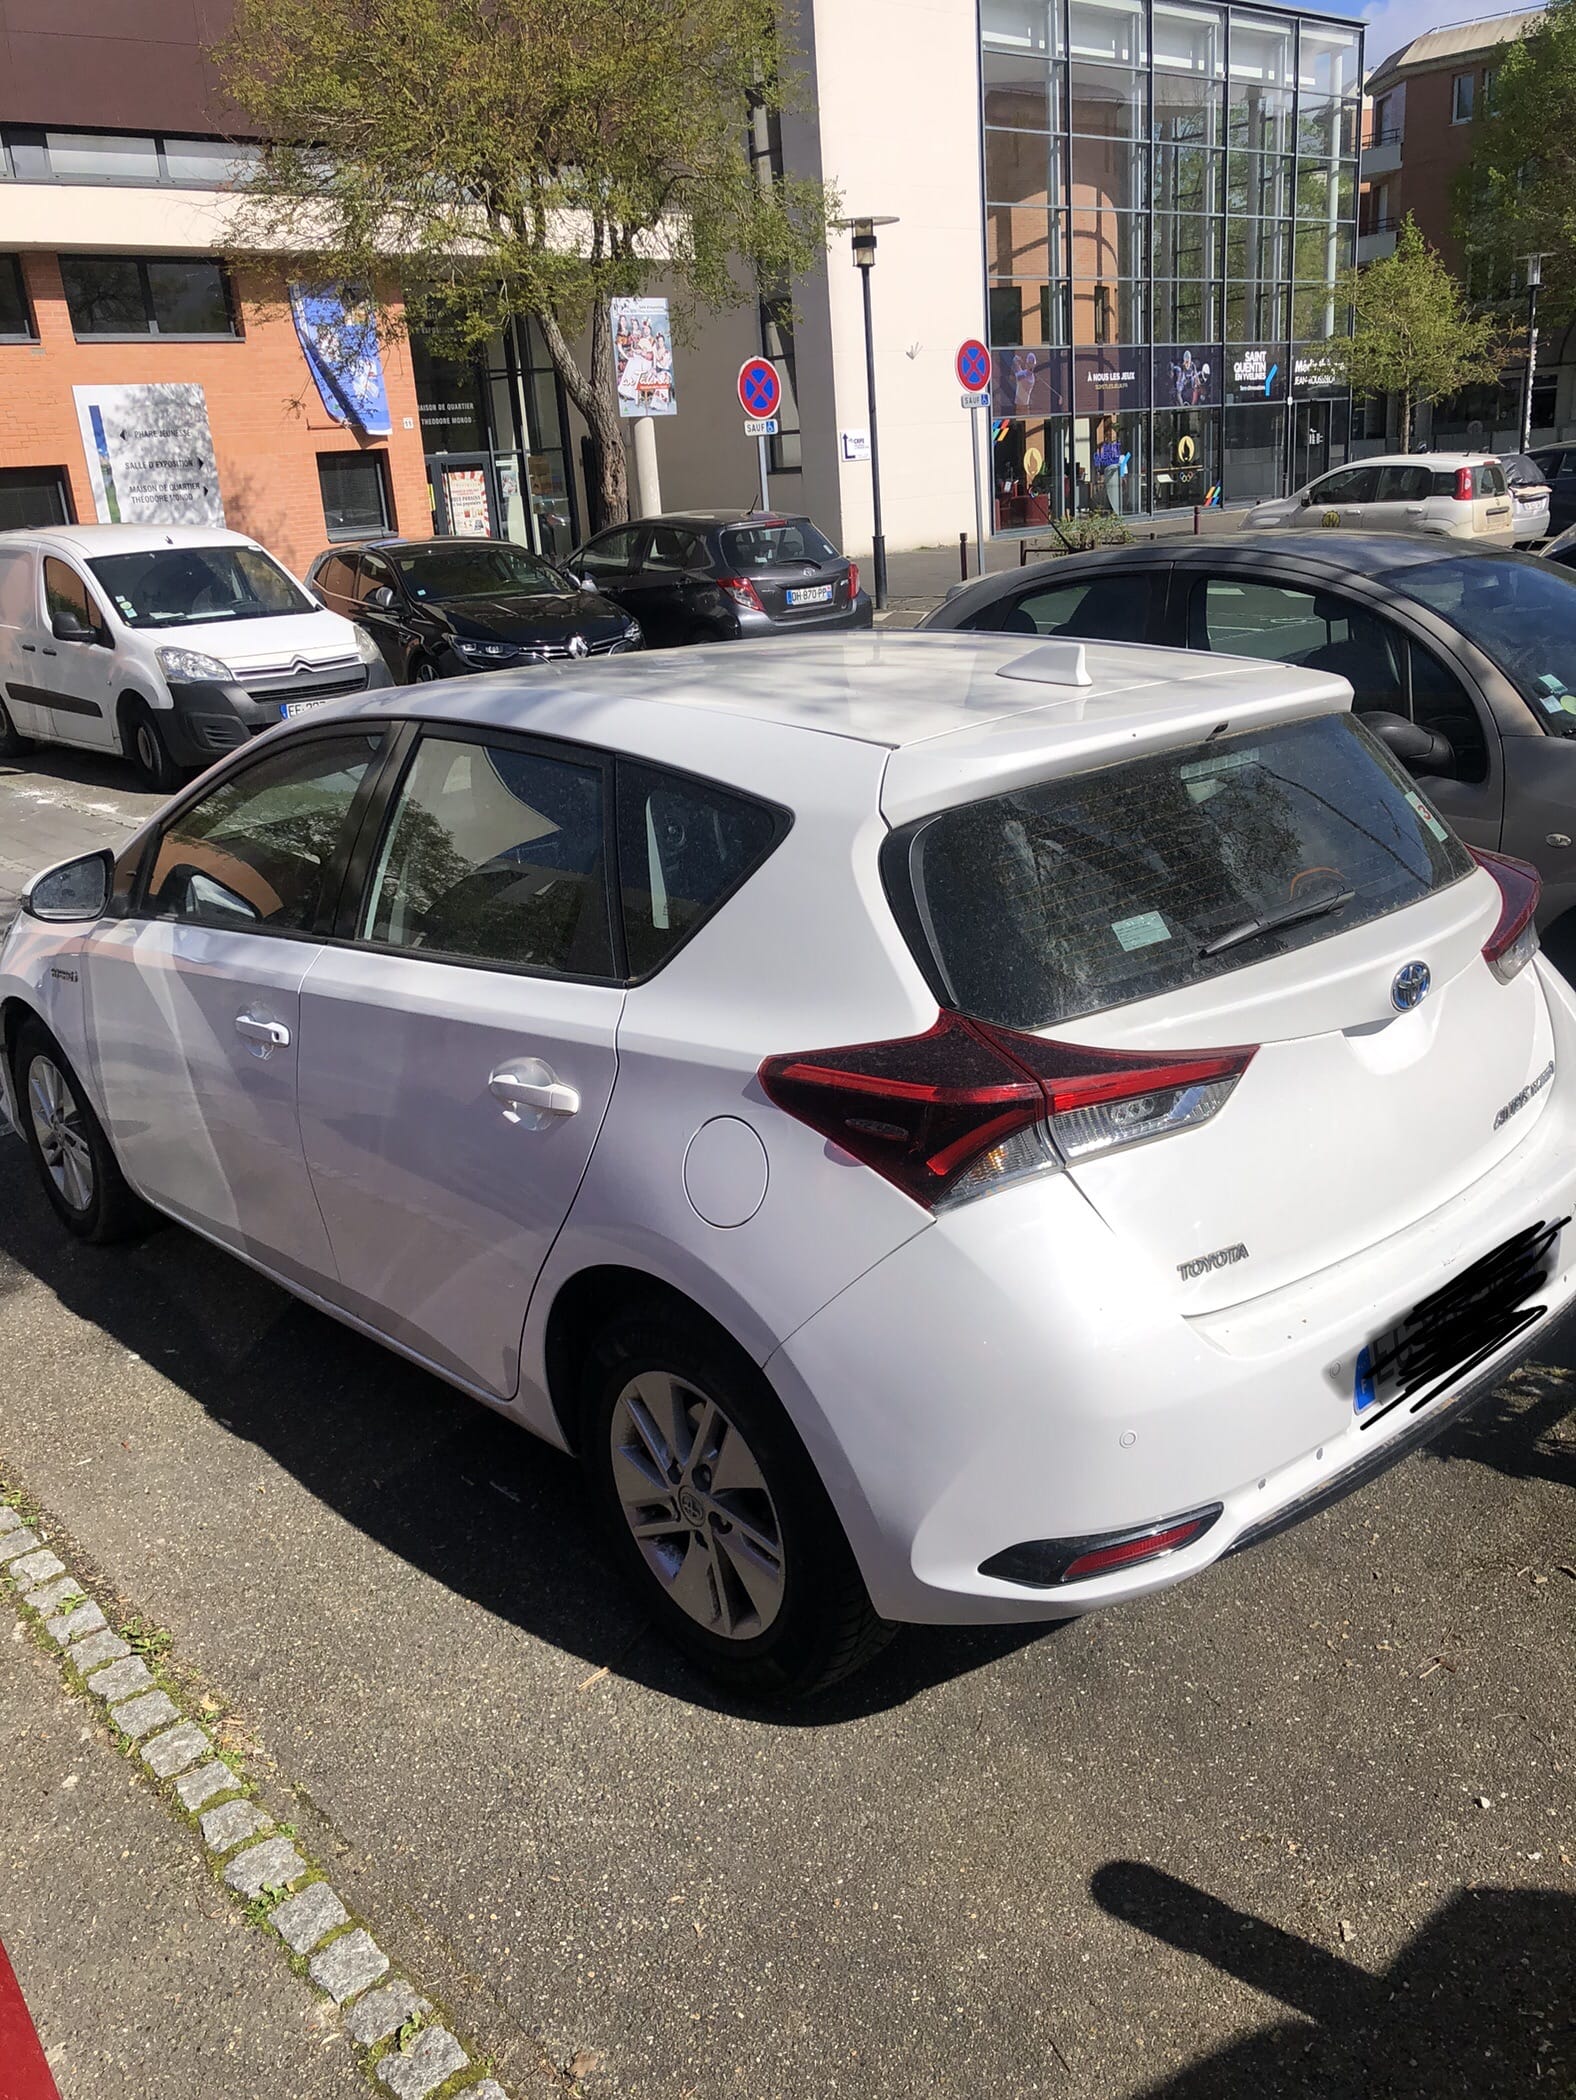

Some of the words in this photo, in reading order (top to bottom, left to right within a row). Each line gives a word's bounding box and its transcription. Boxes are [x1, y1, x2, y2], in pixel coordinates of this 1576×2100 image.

[1244, 350, 1267, 362] SAINT
[1233, 361, 1267, 373] QUENTIN
[1093, 372, 1109, 382] NOUS
[1110, 372, 1120, 381] LES
[1121, 371, 1136, 381] JEUX
[1234, 373, 1243, 381] EN
[1243, 372, 1266, 381] YVELINES
[964, 396, 980, 405] SAUF
[418, 403, 437, 412] AISON
[438, 403, 446, 411] DE
[447, 402, 475, 410] QUARTIER
[451, 416, 472, 424] MONOD
[746, 423, 766, 433] SAUF
[134, 430, 158, 439] PHARE
[159, 429, 192, 438] JEUNESSE
[125, 461, 147, 470] SALLE
[129, 484, 158, 493] MAISON
[159, 484, 169, 492] DE
[169, 482, 201, 492] QUARTIER
[1176, 1242, 1249, 1282] TOYOTA
